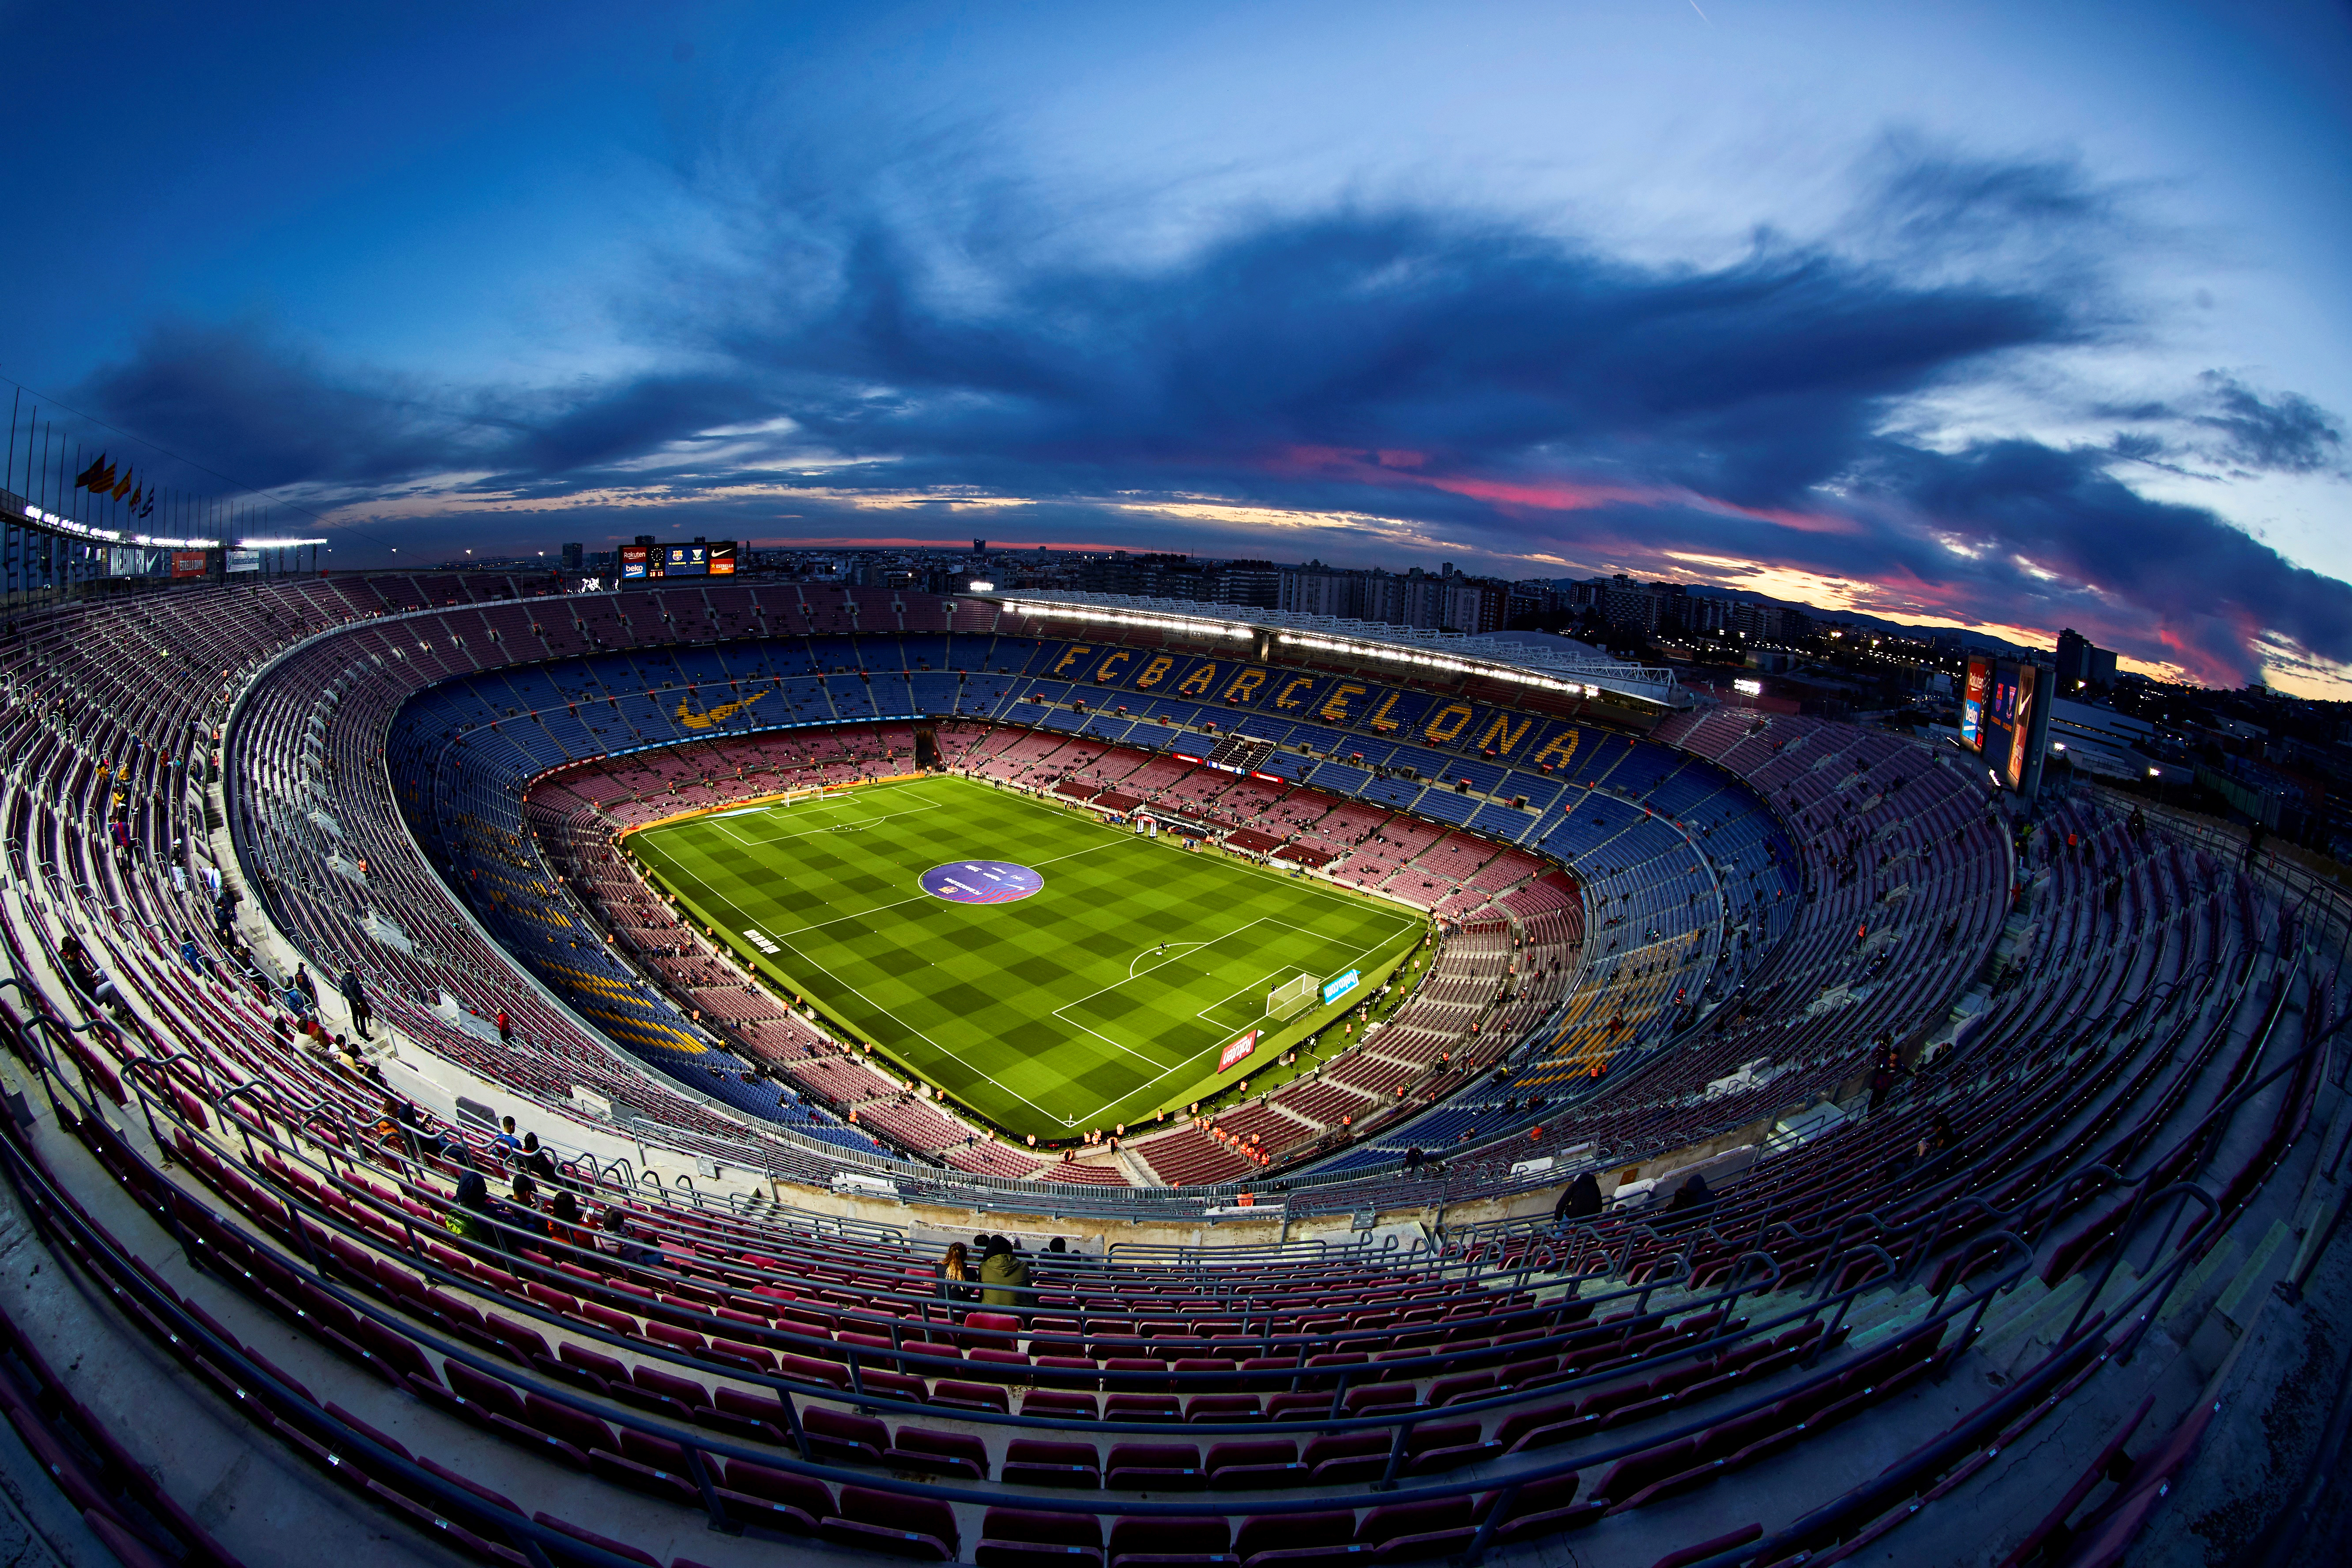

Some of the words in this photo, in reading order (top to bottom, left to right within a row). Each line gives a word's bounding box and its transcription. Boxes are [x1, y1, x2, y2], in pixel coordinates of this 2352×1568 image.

[180, 560, 194, 571] ESTRELLA
[1968, 672, 1983, 690] Rakuten
[1136, 656, 1579, 769] BARCELONA
[1966, 704, 1978, 725] beko
[1325, 971, 1357, 999] beko.com
[1223, 1036, 1253, 1065] Rakuten
